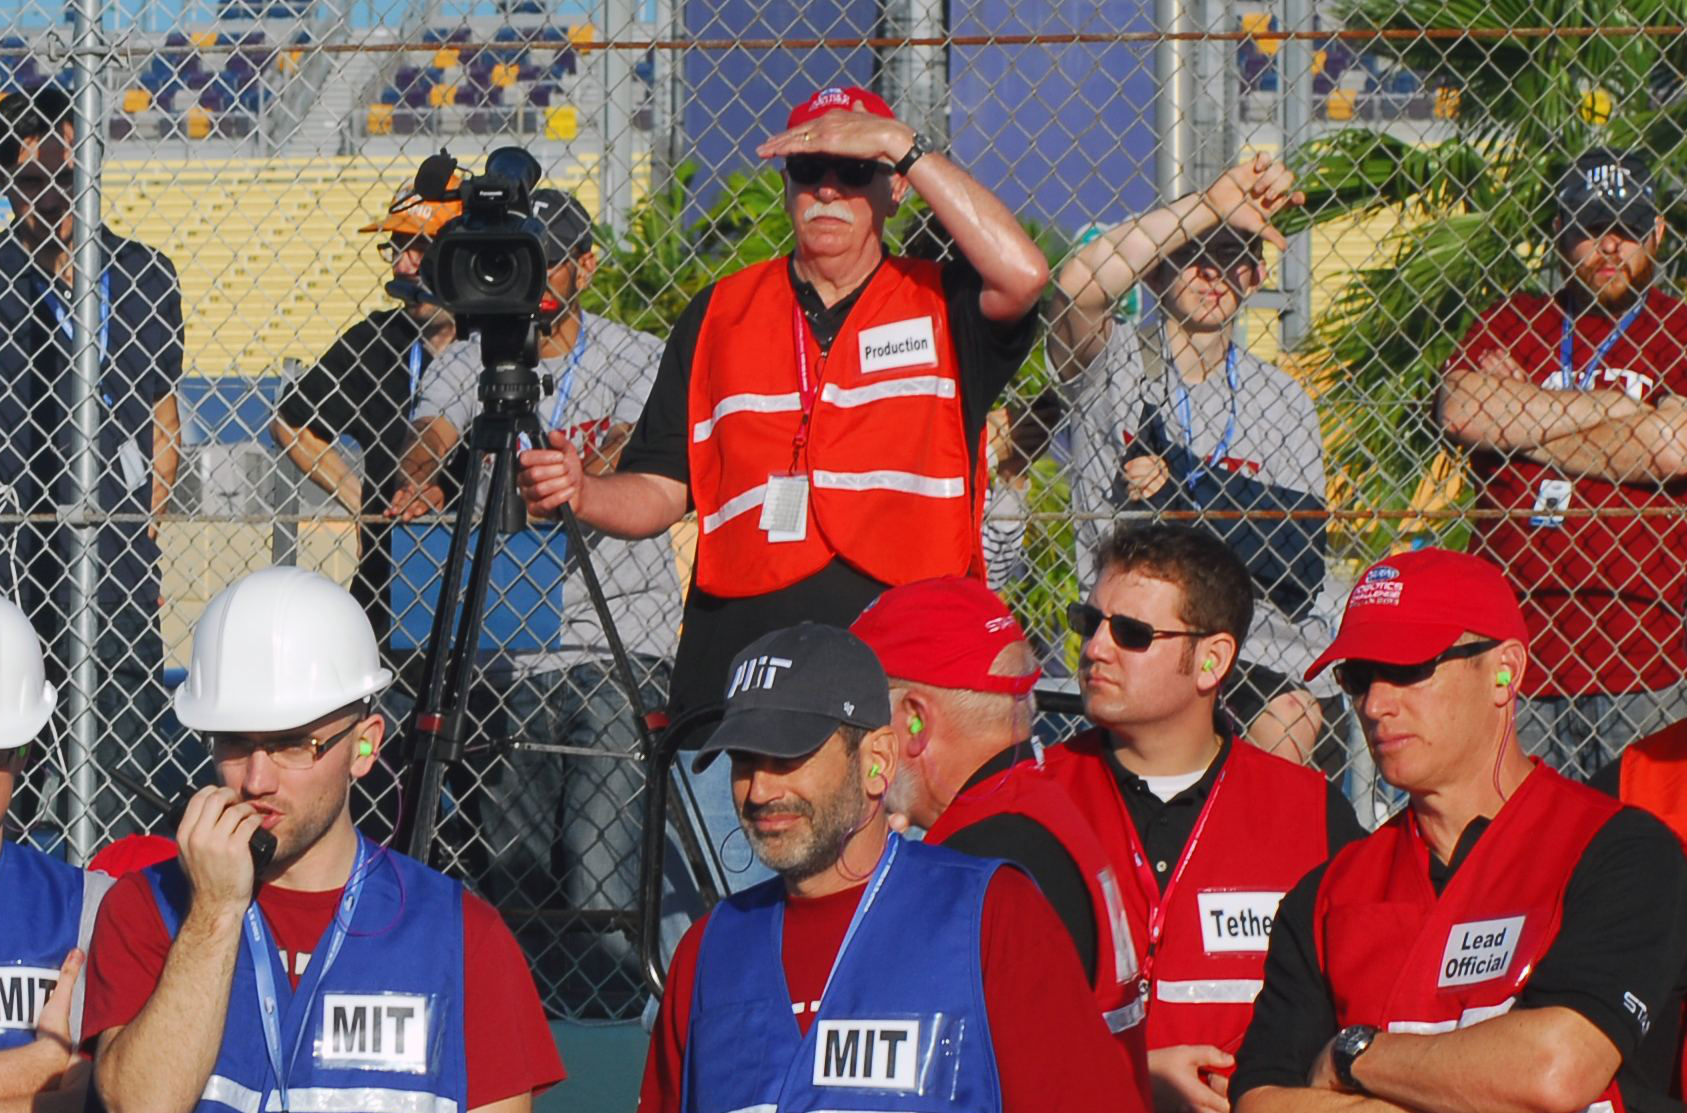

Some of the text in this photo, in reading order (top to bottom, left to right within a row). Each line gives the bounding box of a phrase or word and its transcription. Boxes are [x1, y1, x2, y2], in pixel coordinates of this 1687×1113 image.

[864, 337, 929, 361] Production
[727, 655, 793, 699] MIT
[1461, 927, 1507, 951] Lead
[1445, 951, 1509, 979] Official
[332, 1005, 414, 1054] MIT
[823, 1029, 908, 1079] MIT
